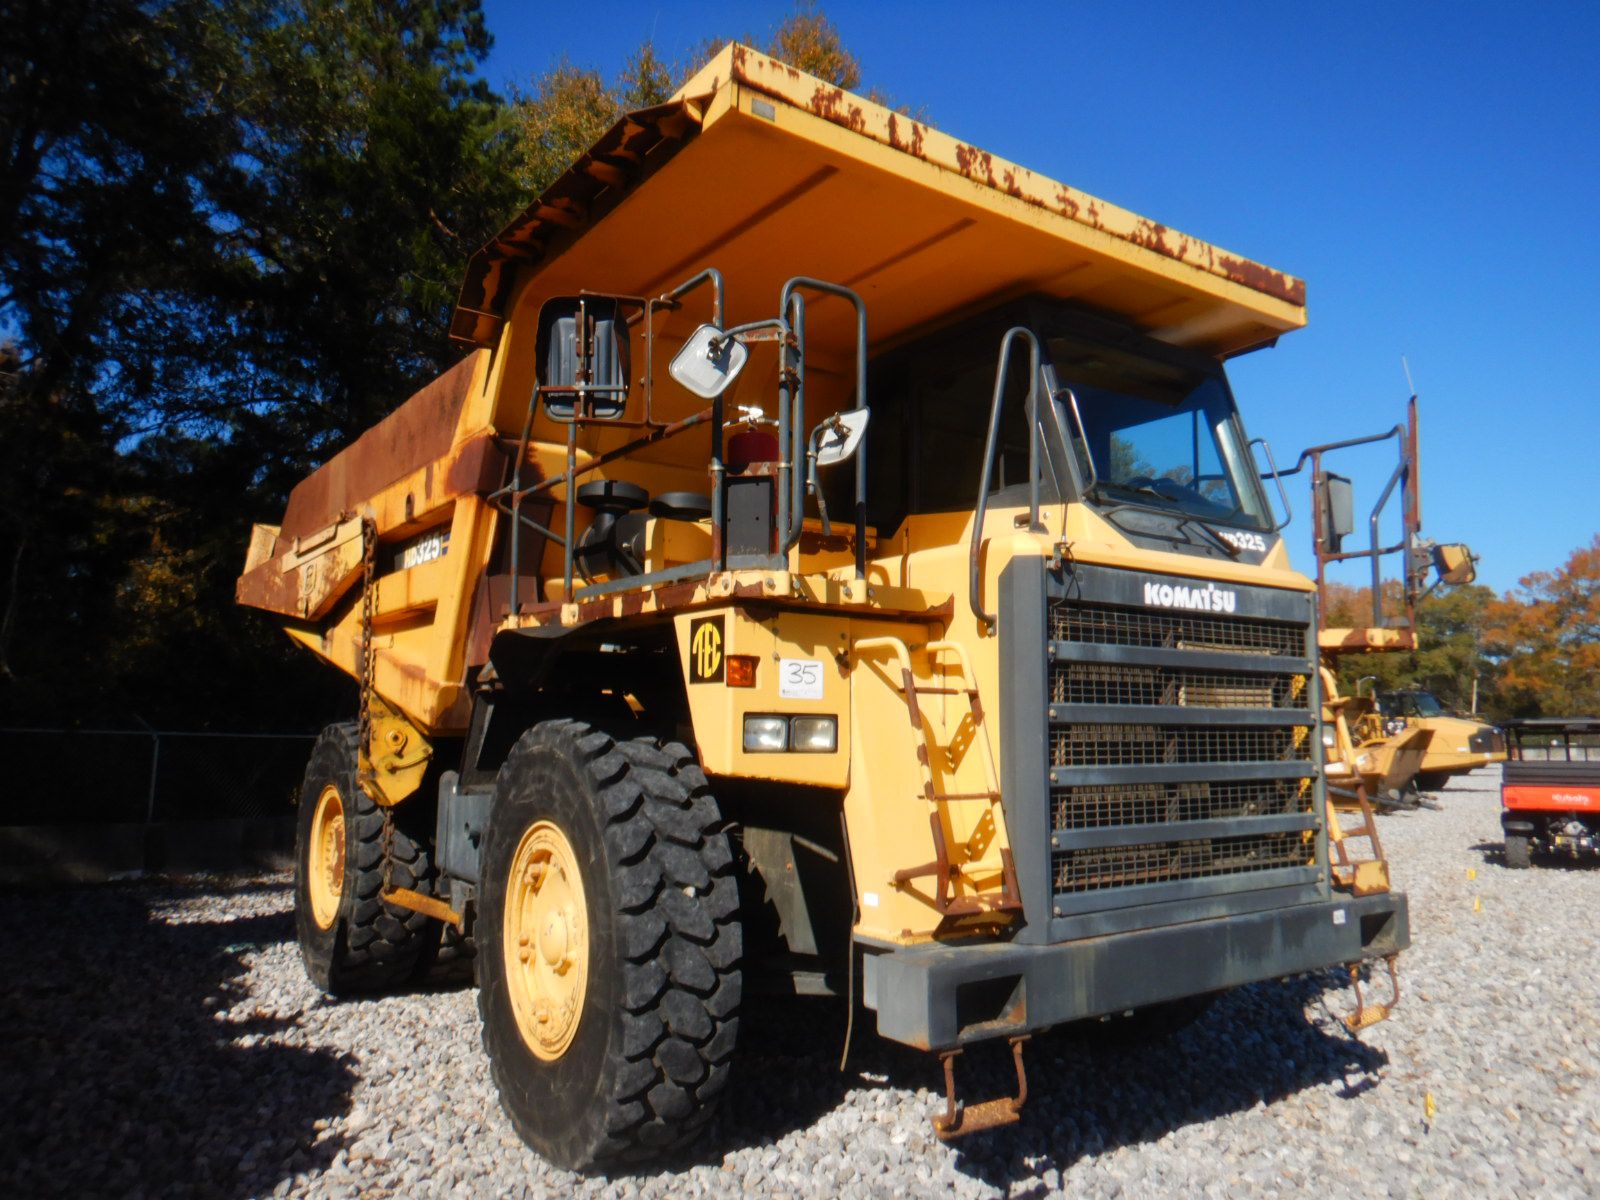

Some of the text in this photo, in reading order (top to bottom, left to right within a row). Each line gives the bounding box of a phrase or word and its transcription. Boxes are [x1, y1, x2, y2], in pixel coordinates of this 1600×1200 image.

[1144, 582, 1236, 613] KOMATSU
[692, 622, 721, 678] TEC
[788, 662, 818, 685] 35
